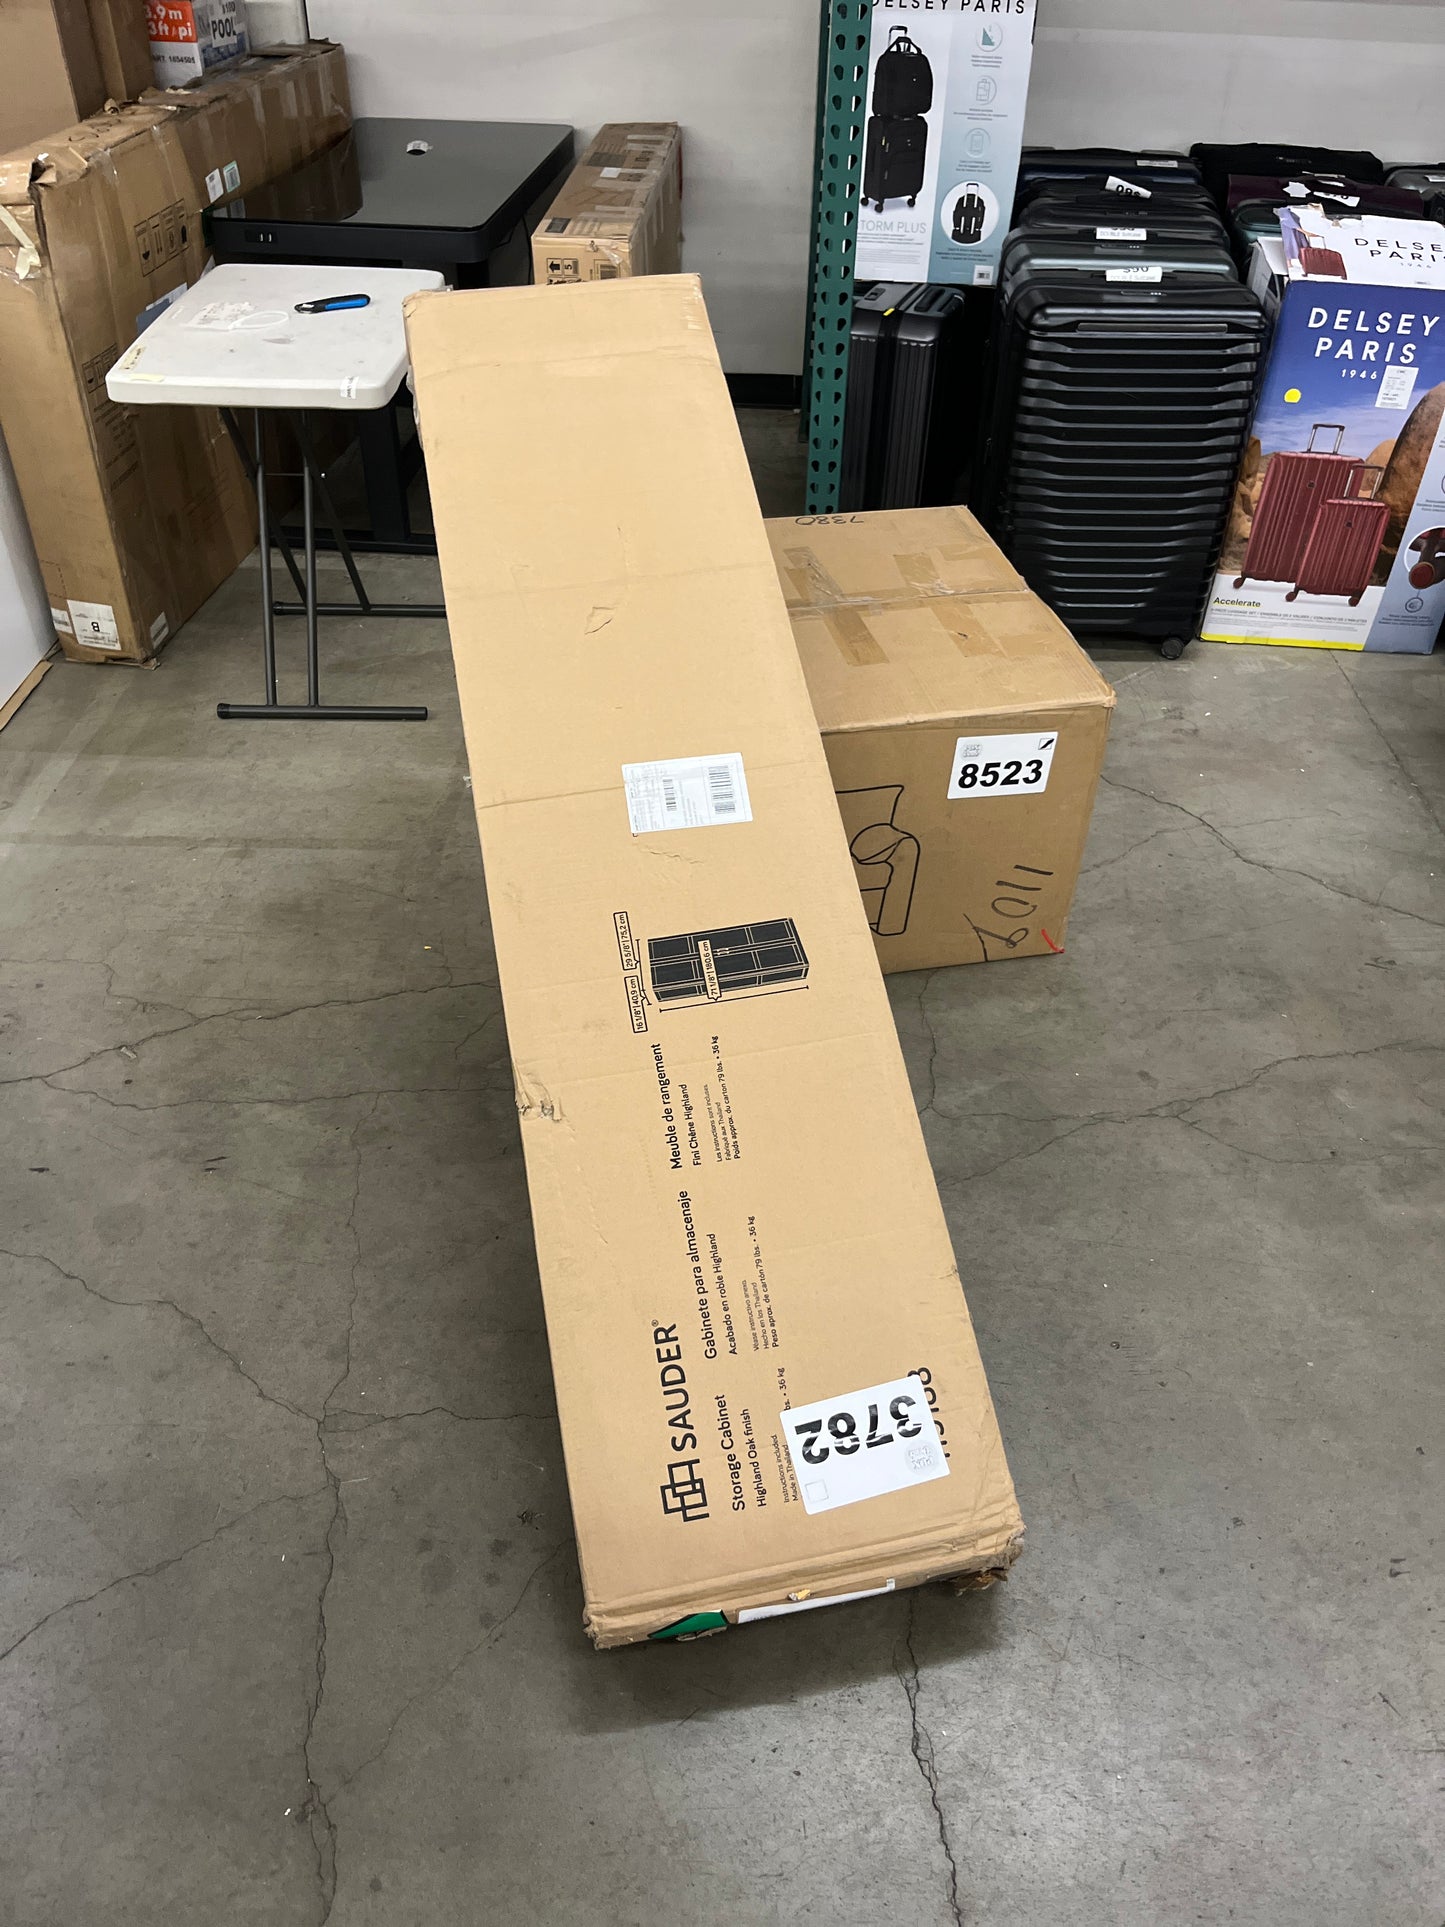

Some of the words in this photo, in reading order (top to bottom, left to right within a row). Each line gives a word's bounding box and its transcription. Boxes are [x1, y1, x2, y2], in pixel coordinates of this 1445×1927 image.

[169, 9, 182, 20] m
[873, 0, 948, 10] ELSEY
[961, 0, 1025, 14] PARIS
[178, 22, 192, 39] pi
[211, 17, 236, 40] POOL
[858, 220, 894, 232] TORM
[897, 222, 926, 234] PLUS
[1370, 250, 1445, 262] PARI
[1308, 308, 1440, 336] DELSEY
[1314, 337, 1416, 364] PARIS
[1341, 368, 1378, 380] 1946
[1213, 596, 1261, 608] Accelerate
[958, 759, 1044, 789] 8523
[619, 914, 626, 924] cm
[703, 942, 708, 952] cm
[626, 956, 634, 968] 29
[630, 978, 636, 988] cm
[711, 1036, 718, 1044] kg
[712, 1044, 720, 1054] 36
[651, 1043, 671, 1105] rangement
[718, 1074, 725, 1082] 79
[678, 1084, 694, 1120] Highland
[721, 1083, 730, 1104] carton
[662, 1108, 674, 1122] de
[726, 1105, 732, 1114] du
[688, 1122, 698, 1149] Chêne
[709, 1120, 720, 1152] instructions
[728, 1115, 738, 1140] approx.
[665, 1125, 682, 1170] Meuble
[730, 1141, 740, 1160] Poids
[693, 1151, 702, 1166] Fini
[678, 1190, 700, 1263] almacenaje
[748, 1216, 756, 1226] kg
[750, 1226, 756, 1236] 36
[706, 1234, 722, 1274] Highland
[756, 1259, 762, 1270] 79
[692, 1266, 708, 1294] para
[716, 1275, 726, 1298] roble
[758, 1270, 768, 1292] cartón
[722, 1300, 730, 1312] en
[763, 1293, 770, 1304] de
[743, 1300, 754, 1333] instructivo
[758, 1318, 764, 1328] en
[766, 1305, 776, 1327] aprox.
[698, 1298, 718, 1360] Gabinete
[723, 1314, 738, 1355] Acabado
[760, 1328, 769, 1350] Hecho
[769, 1328, 780, 1348] Peso
[777, 1368, 785, 1378] kg
[780, 1378, 787, 1390] 36
[714, 1394, 734, 1450] Cabinet
[740, 1408, 753, 1436] finish
[794, 1394, 922, 1466] 3782
[746, 1438, 758, 1459] Oak
[782, 1444, 792, 1474] Thailand
[727, 1454, 745, 1511] Storage
[748, 1462, 766, 1508] Highland
[778, 1462, 790, 1503] Instructions
[790, 1483, 798, 1502] Made
